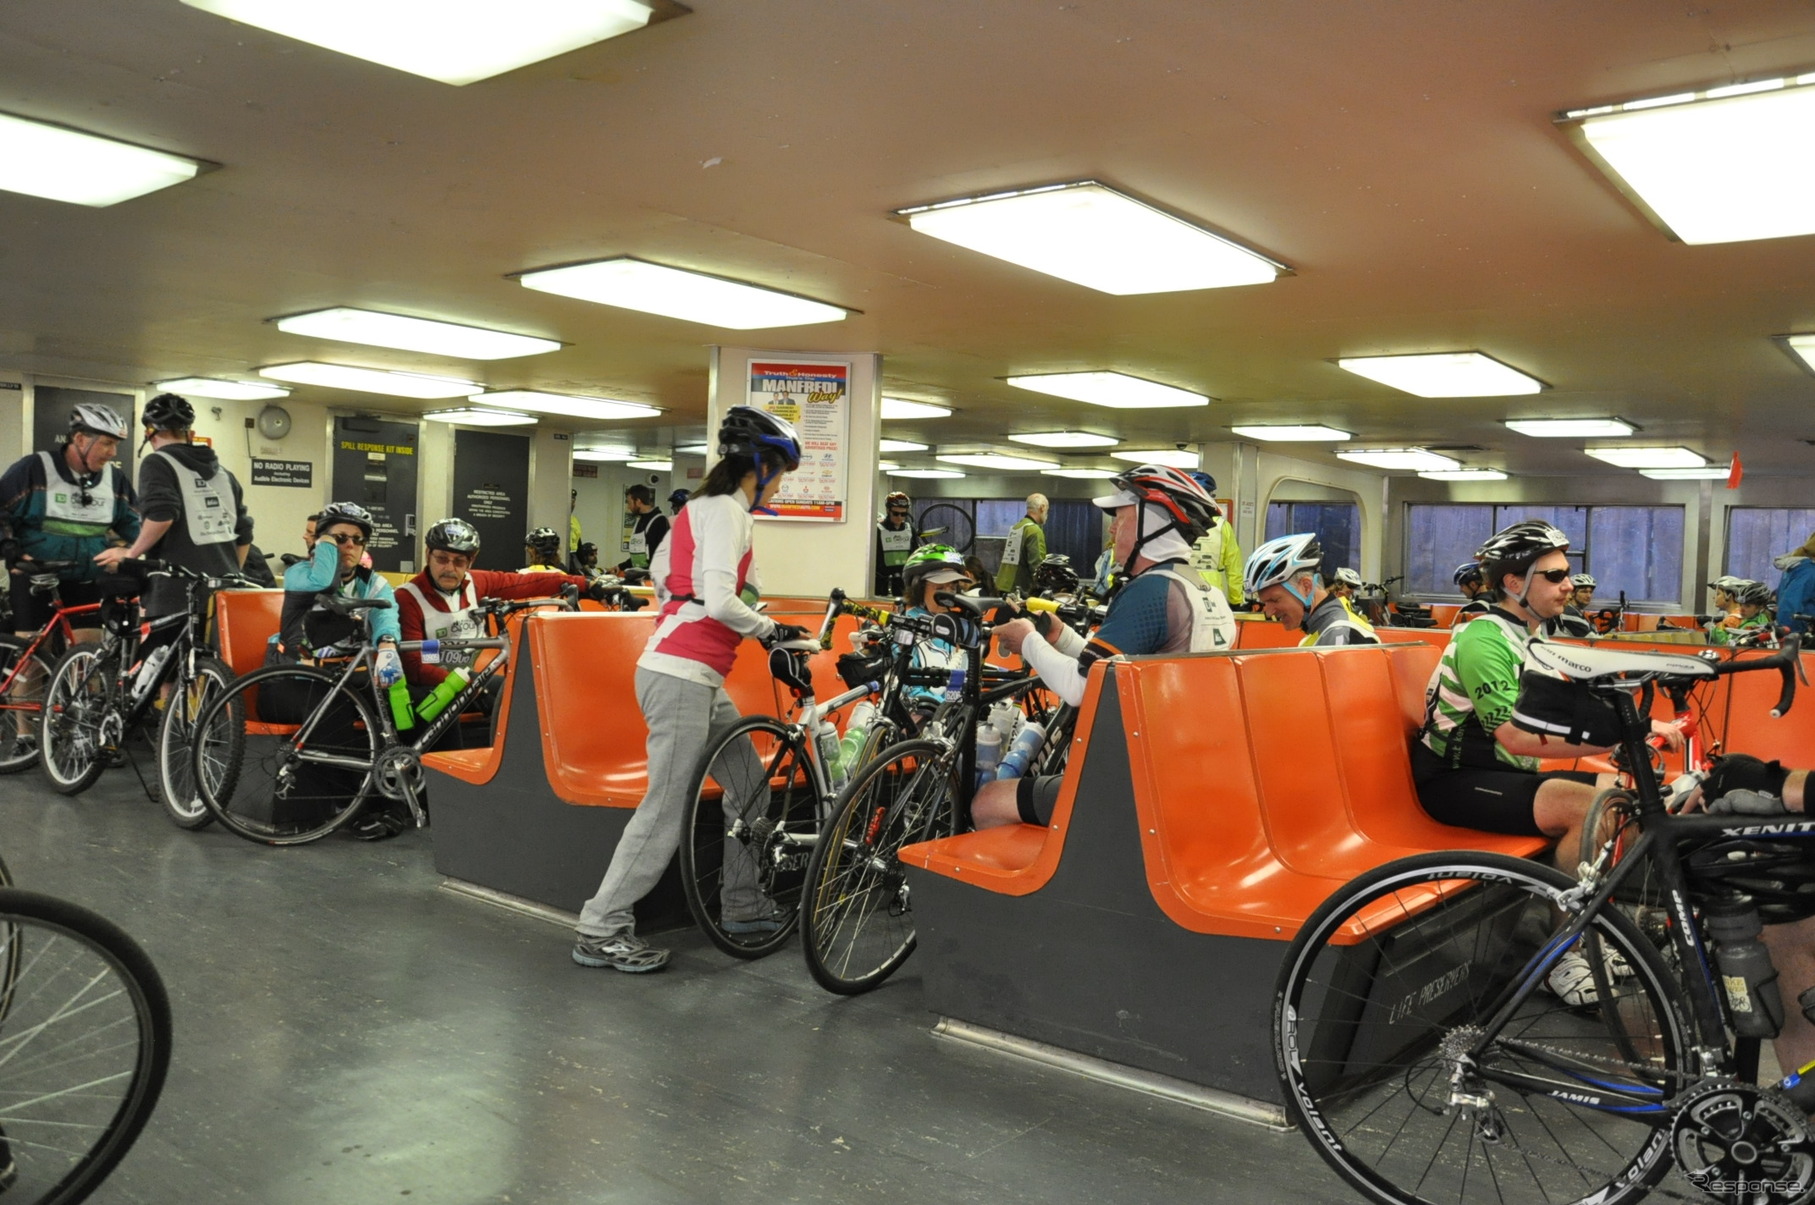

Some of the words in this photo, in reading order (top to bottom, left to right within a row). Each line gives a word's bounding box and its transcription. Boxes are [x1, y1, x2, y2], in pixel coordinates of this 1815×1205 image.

[762, 379, 838, 394] MANFREDI
[807, 388, 843, 403] Way!
[341, 441, 356, 450] SPILL
[357, 443, 385, 452] RESPONSE
[386, 445, 395, 453] KIT
[395, 446, 414, 455] INSIDE
[253, 462, 264, 470] NO
[265, 462, 284, 470] RADIO
[285, 463, 310, 472] PLAYING
[1558, 655, 1592, 673] marco
[1474, 679, 1511, 700] 2012
[1672, 889, 1695, 947] COMP
[1389, 991, 1417, 1025] LIFE
[1418, 959, 1473, 1006] PRESERVERS
[1550, 1089, 1600, 1105] JAMIS
